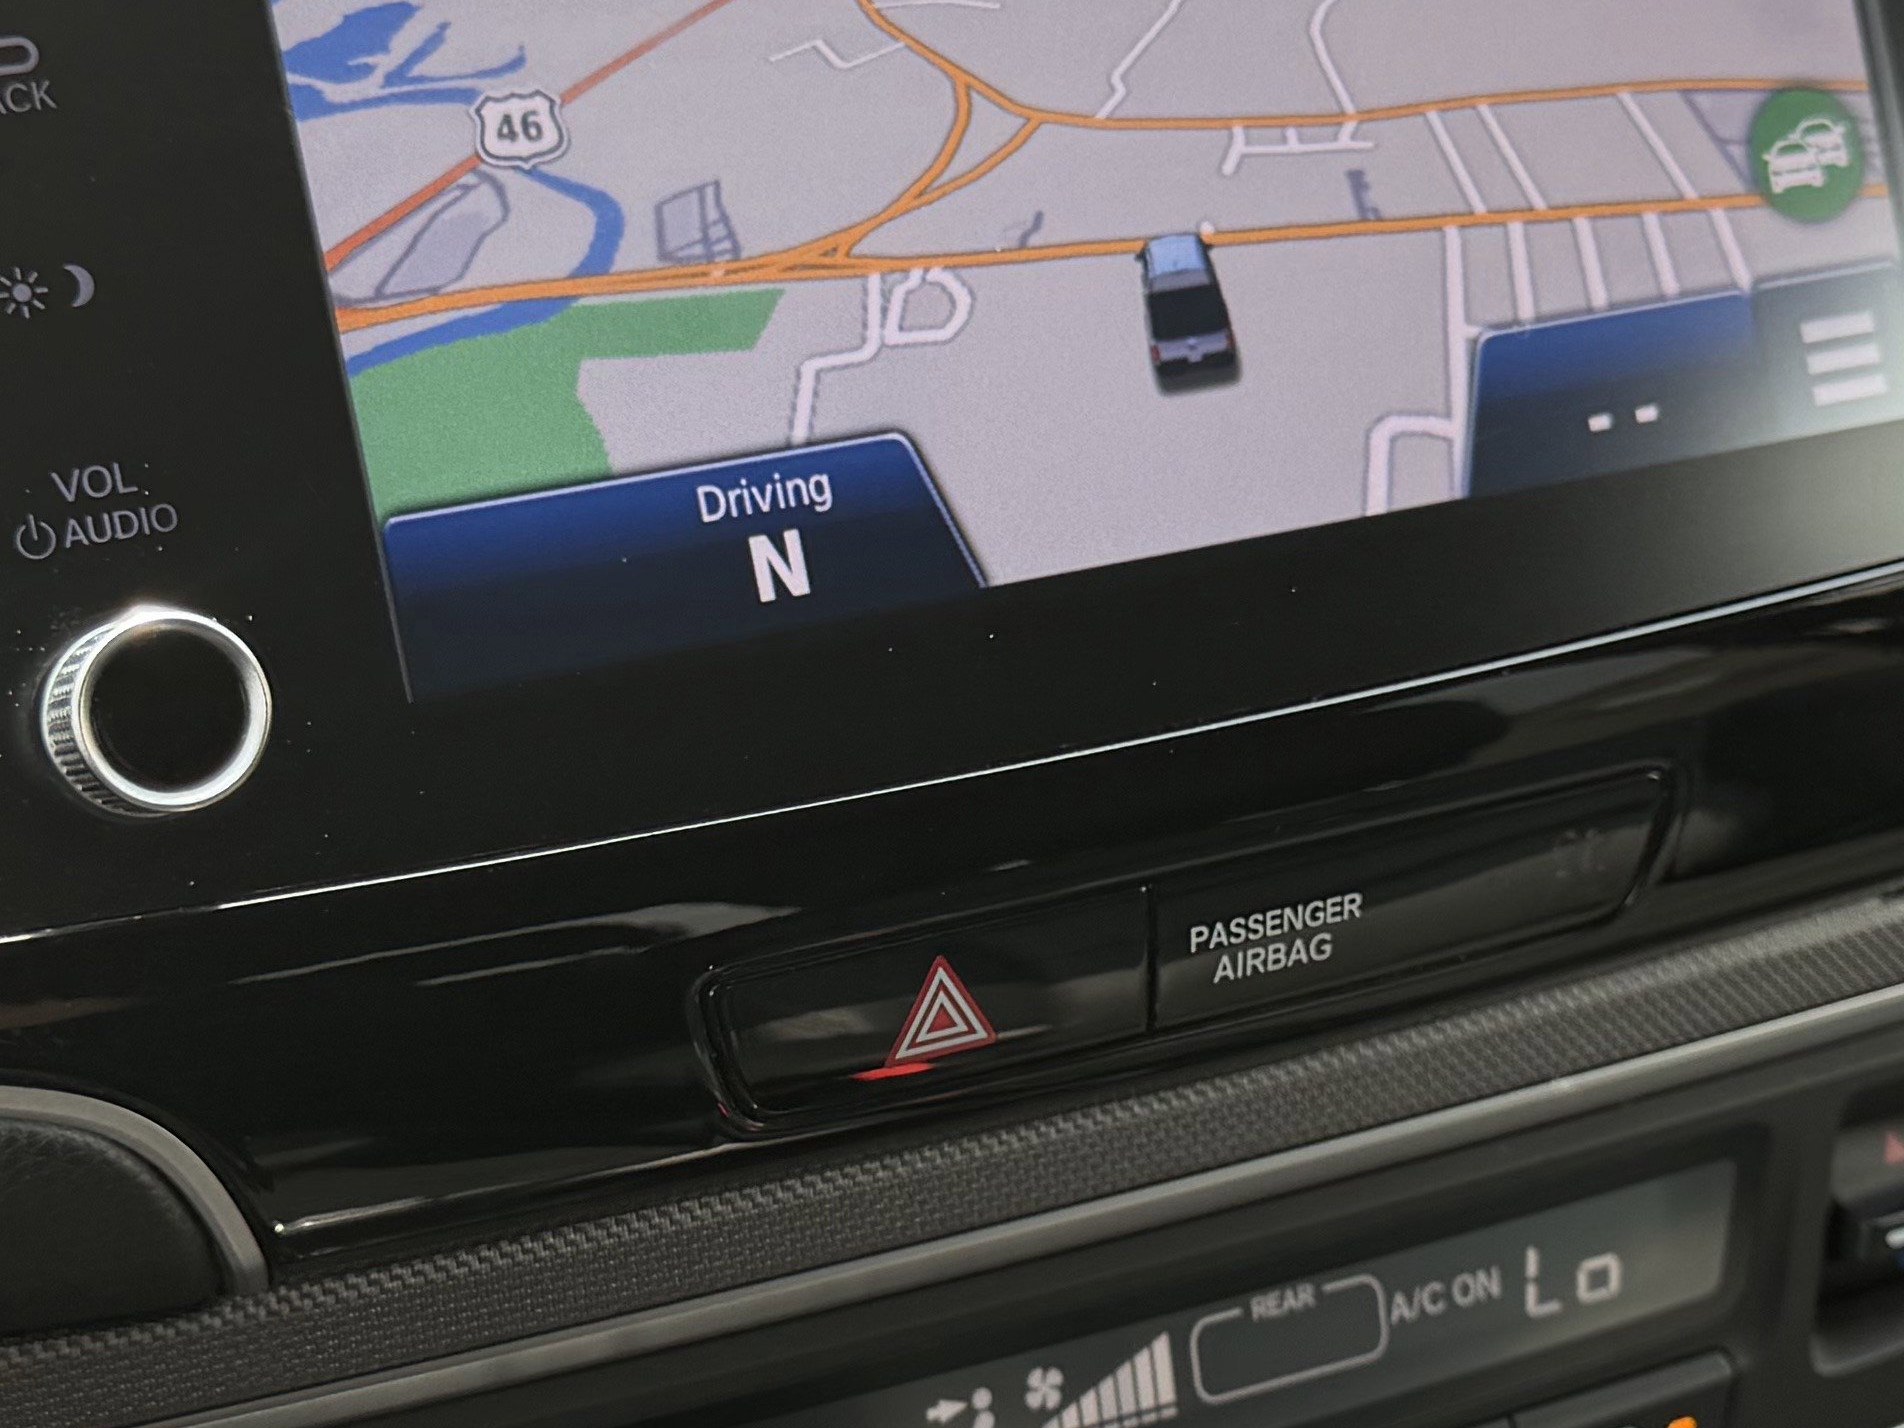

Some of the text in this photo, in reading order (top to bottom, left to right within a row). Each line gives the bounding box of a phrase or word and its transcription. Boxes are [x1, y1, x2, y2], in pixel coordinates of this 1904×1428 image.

[496, 110, 543, 146] 46
[52, 461, 139, 504] VOL
[697, 467, 834, 524] Driving
[63, 501, 179, 546] AUDIO
[747, 529, 812, 603] N
[1188, 890, 1364, 955] PASSENGER
[1212, 932, 1334, 984] AIRBAG
[1250, 1283, 1315, 1322] REAR
[1389, 1265, 1502, 1327] A/C ON
[1525, 1246, 1623, 1318] Lo
